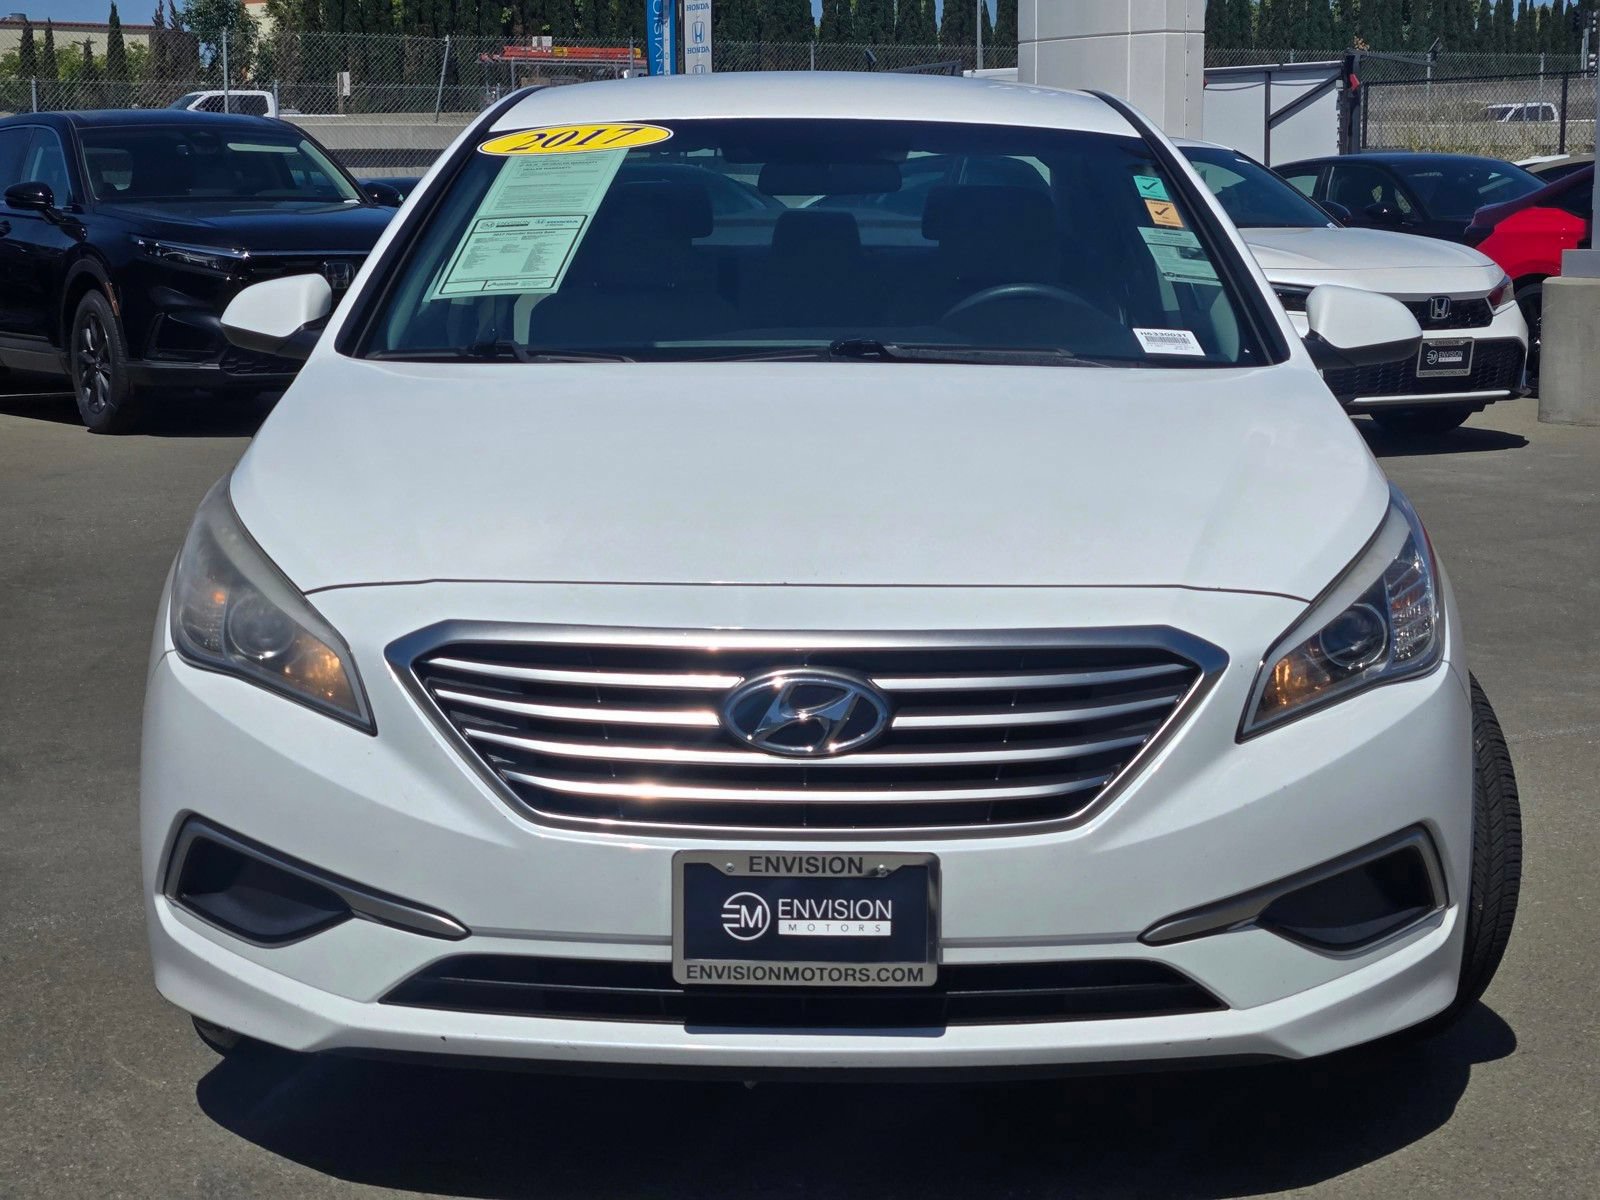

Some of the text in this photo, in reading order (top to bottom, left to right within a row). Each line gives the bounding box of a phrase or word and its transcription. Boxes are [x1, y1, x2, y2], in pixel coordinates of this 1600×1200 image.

[687, 3, 709, 11] HONDA
[687, 46, 710, 54] HONDA
[506, 127, 644, 152] 2017
[749, 855, 864, 875] ENVISION
[778, 898, 892, 920] ENVISION
[788, 923, 881, 933] MOTORS
[686, 964, 924, 983] ENVISIONMOTORS.COM
